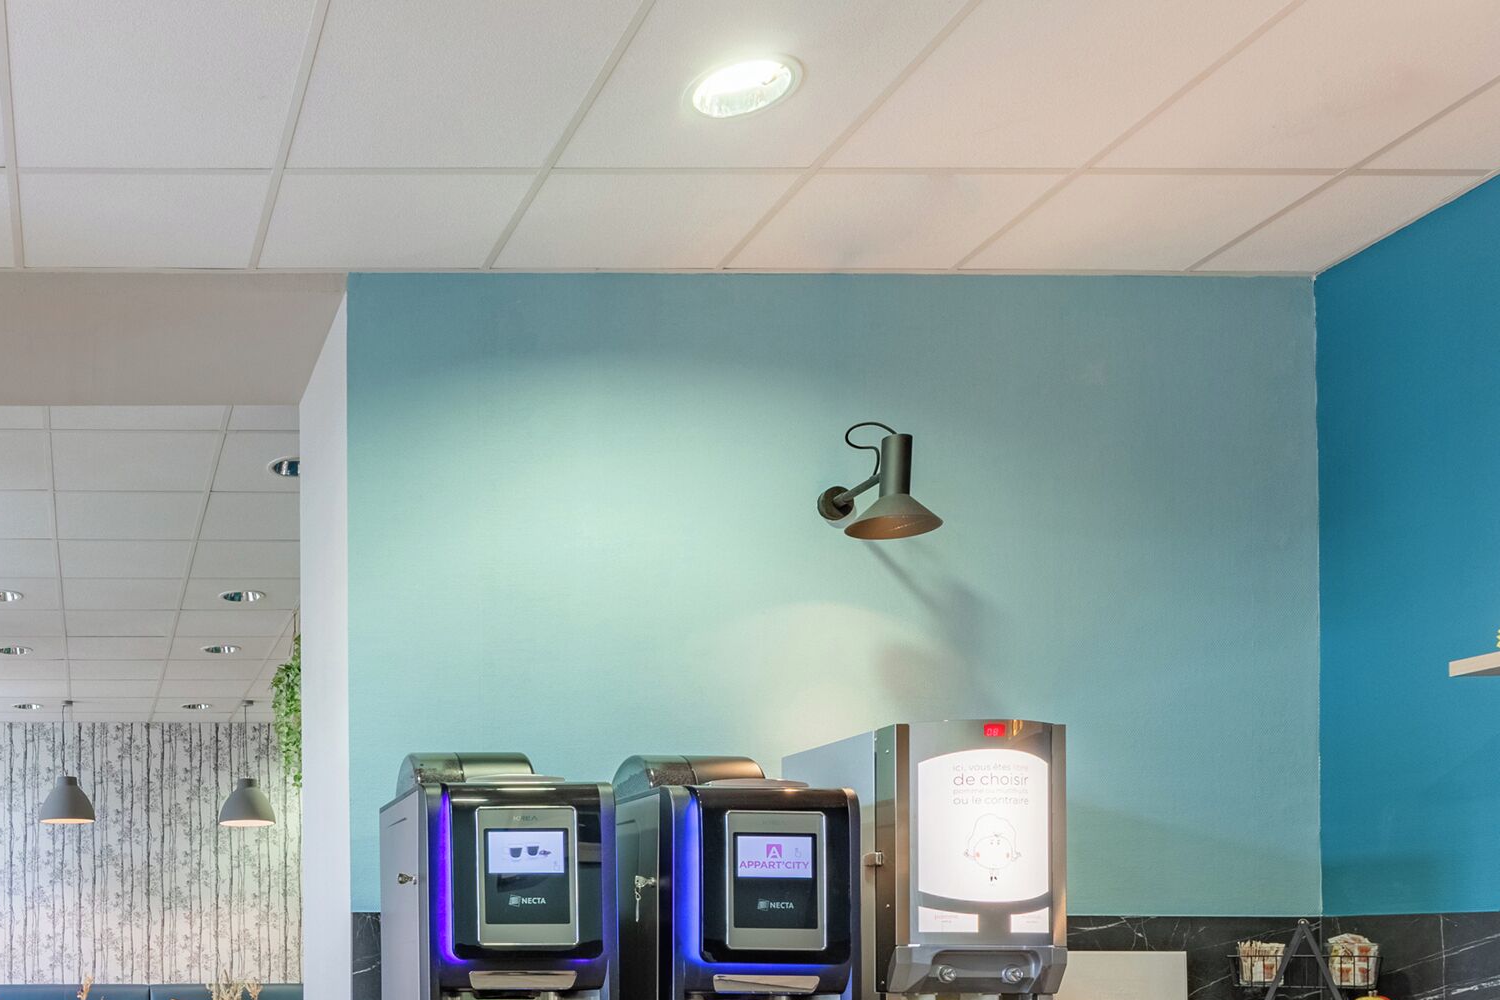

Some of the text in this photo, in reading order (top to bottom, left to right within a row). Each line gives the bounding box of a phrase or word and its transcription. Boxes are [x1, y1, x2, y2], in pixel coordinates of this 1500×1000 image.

[953, 773, 1029, 786] de choisir
[953, 796, 1029, 805] ou le contraire
[740, 861, 809, 869] APPART'CITY
